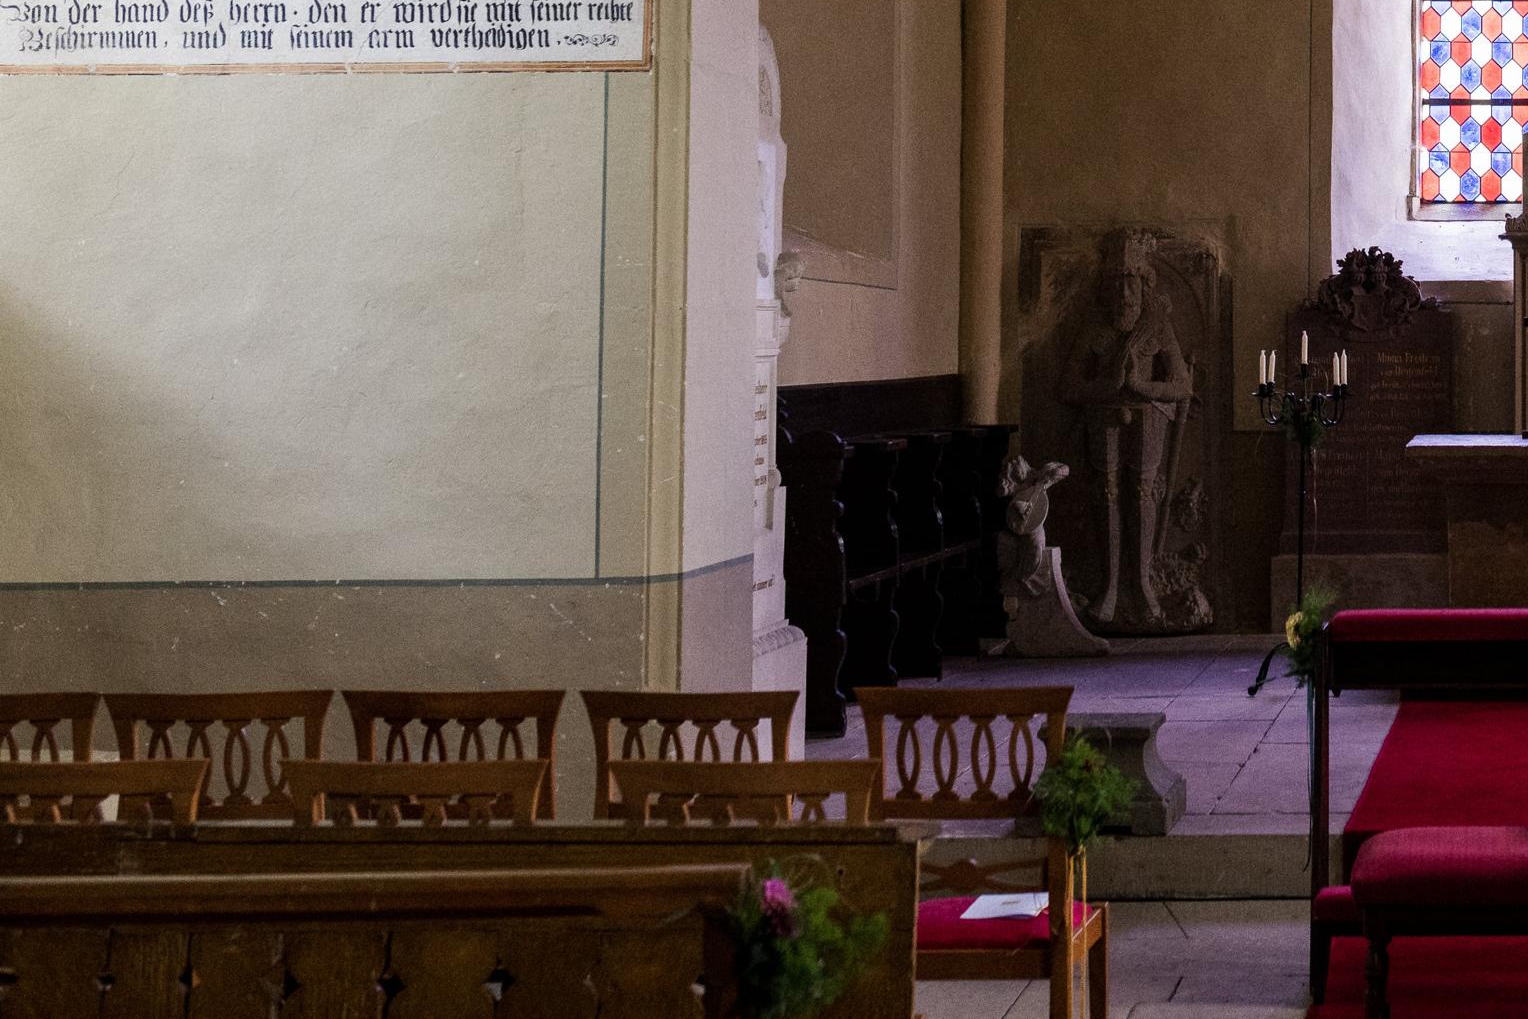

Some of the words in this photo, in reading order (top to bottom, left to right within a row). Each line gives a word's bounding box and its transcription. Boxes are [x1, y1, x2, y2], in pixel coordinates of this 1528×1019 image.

[360, 0, 381, 23] er
[457, 0, 478, 25] sie
[183, 22, 226, 49] und
[241, 24, 273, 50] mit
[289, 24, 353, 51] seinem
